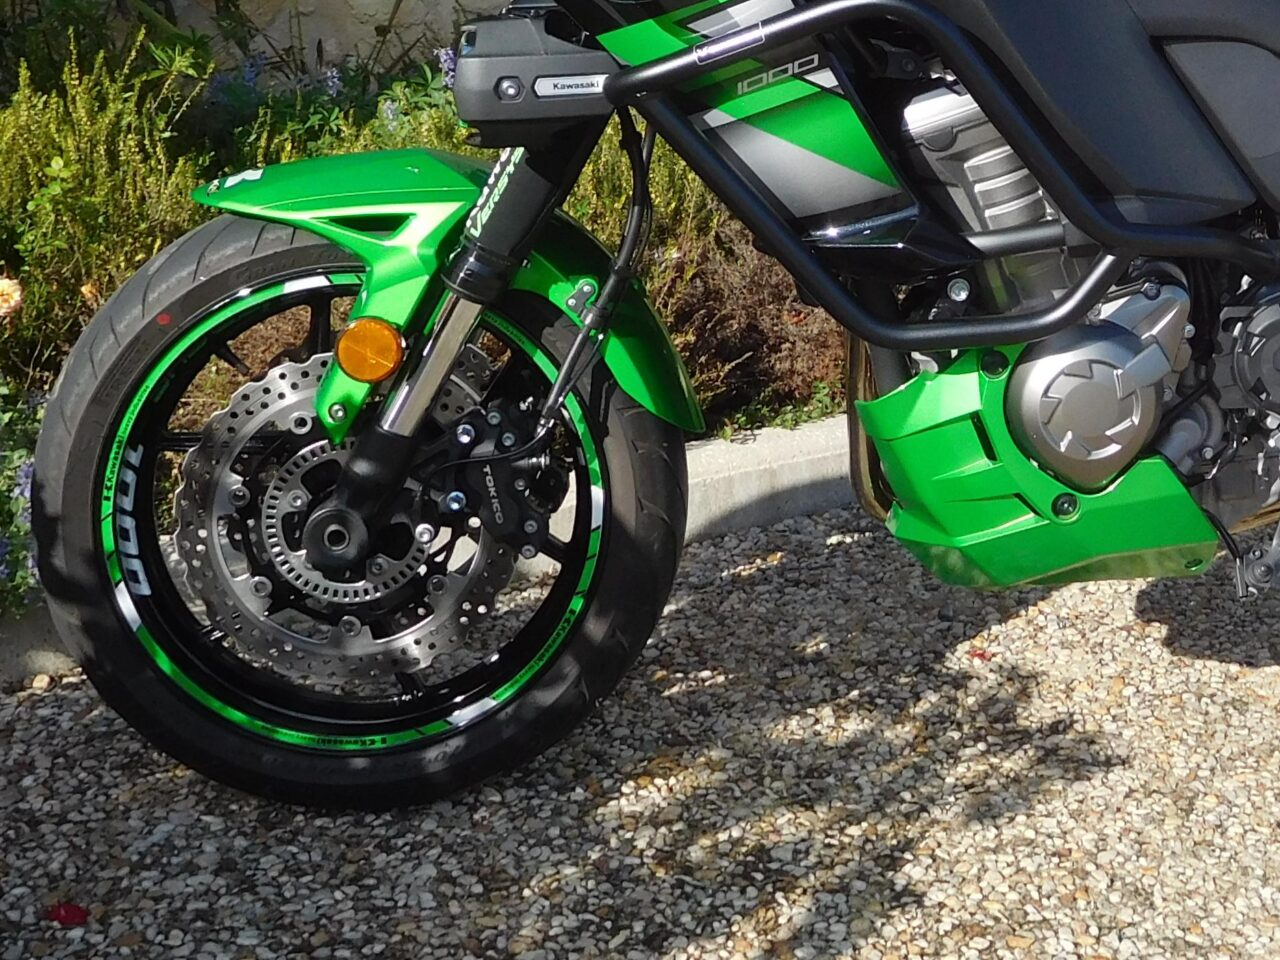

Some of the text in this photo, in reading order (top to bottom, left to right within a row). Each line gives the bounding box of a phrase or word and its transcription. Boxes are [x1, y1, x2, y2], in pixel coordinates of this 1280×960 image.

[553, 81, 599, 90] Kawasaki
[737, 54, 819, 95] 1000
[470, 146, 525, 238] VERSYS
[116, 443, 152, 596] 1000
[483, 464, 504, 524] TOKICO
